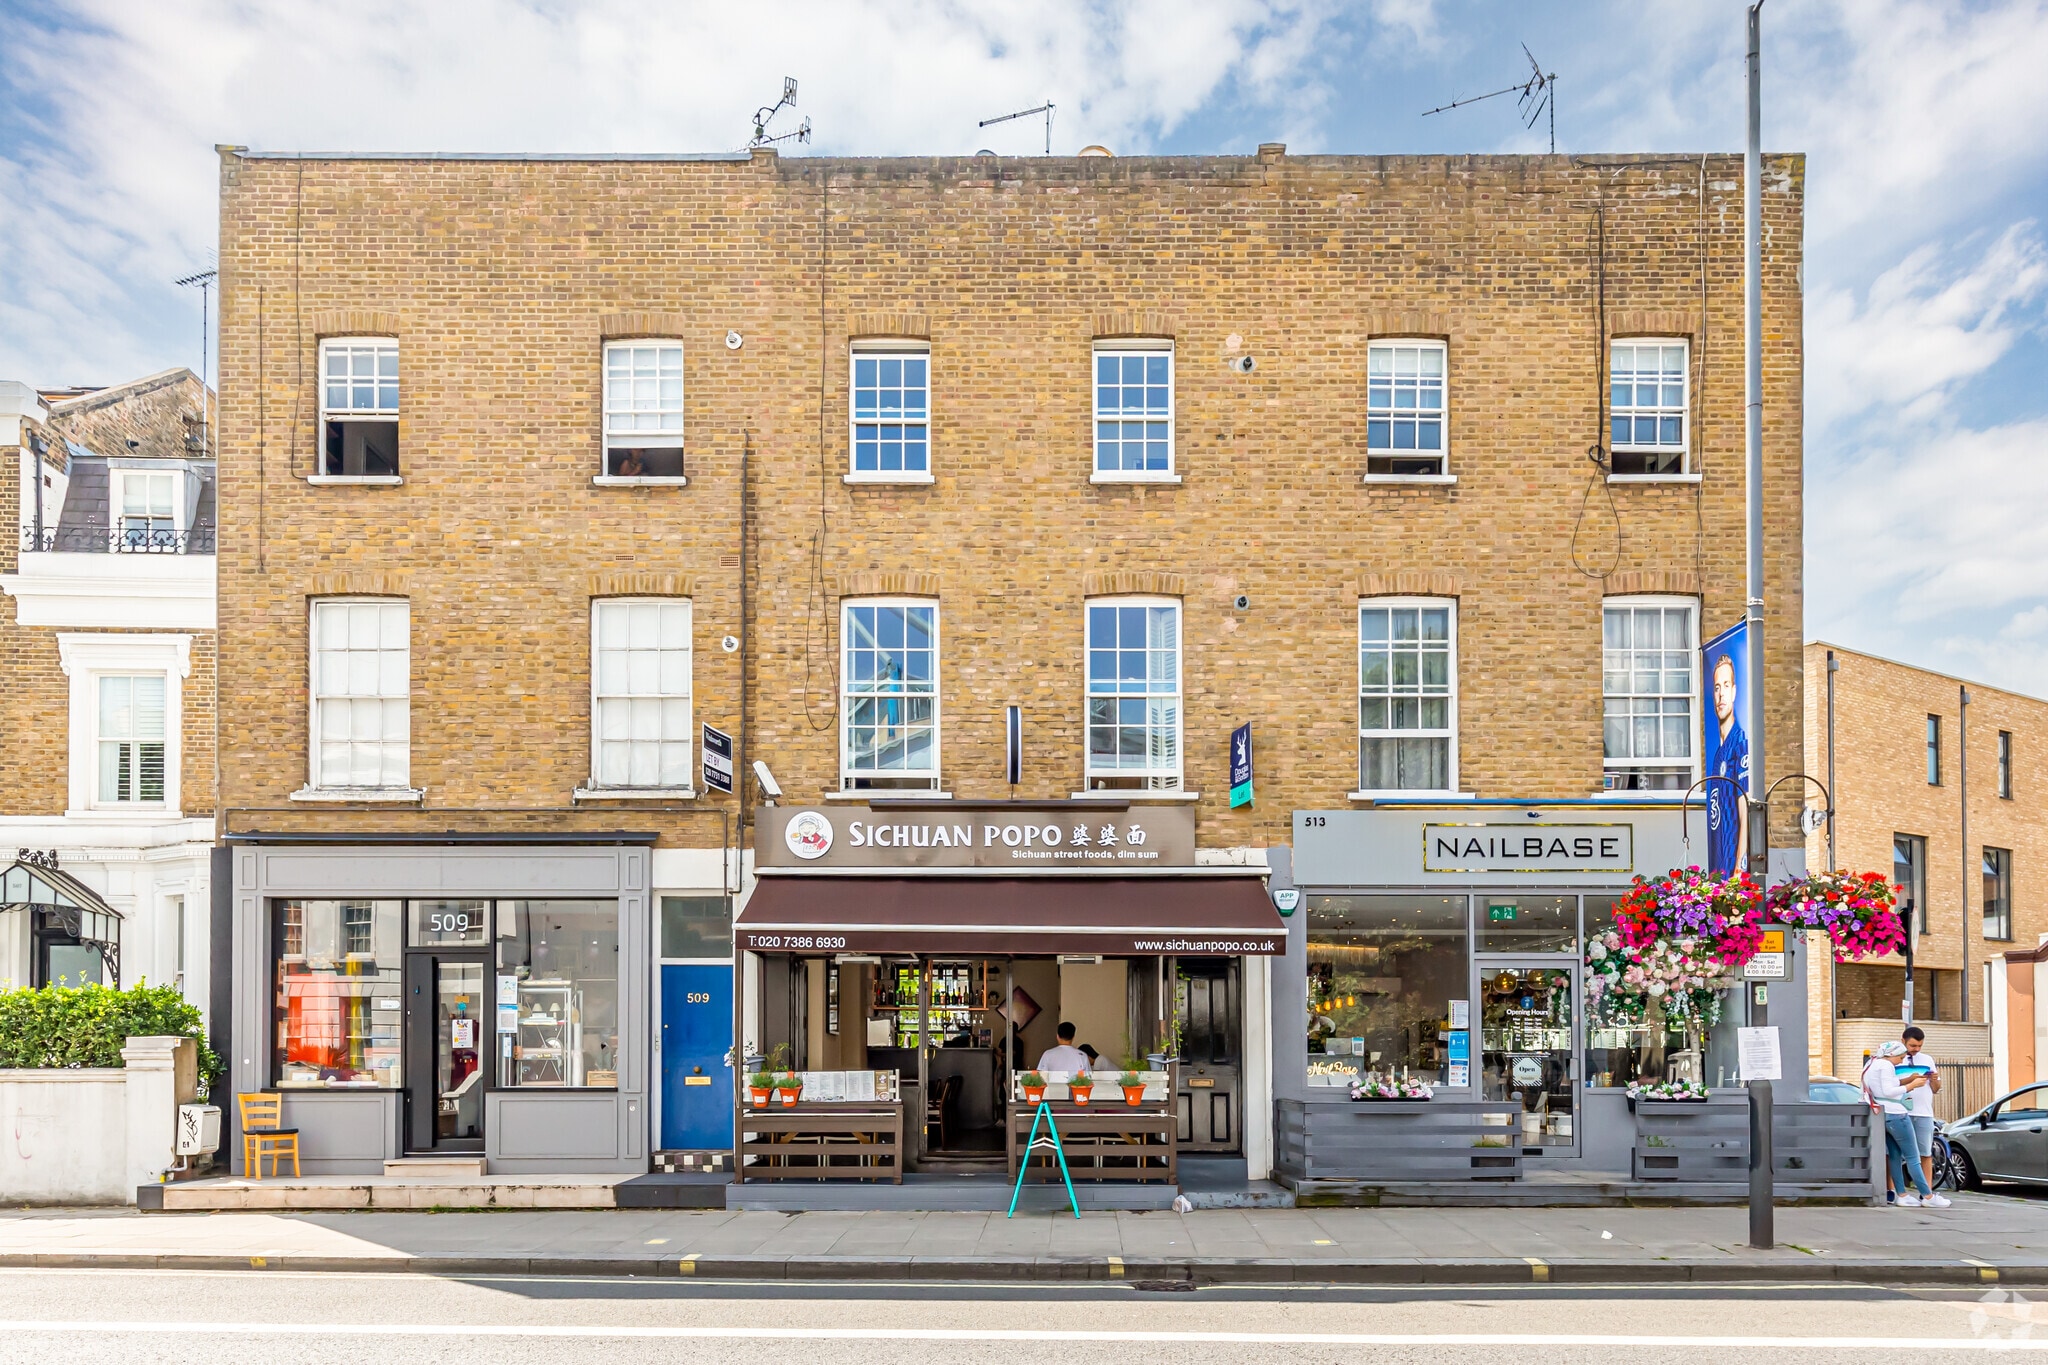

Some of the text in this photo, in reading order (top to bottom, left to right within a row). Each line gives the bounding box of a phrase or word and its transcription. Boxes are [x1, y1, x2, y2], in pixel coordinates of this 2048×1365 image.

[1305, 817, 1326, 827] 513
[984, 825, 1062, 847] POPO
[1437, 837, 1619, 858] NAILBASE
[1012, 850, 1159, 860] Sichuan street foods, dim sum
[430, 913, 469, 932] 509
[783, 936, 813, 948] 7386
[815, 937, 846, 949] 6930
[1134, 939, 1275, 953] www.sichuanpopo.co.uk
[687, 993, 710, 1003] 509
